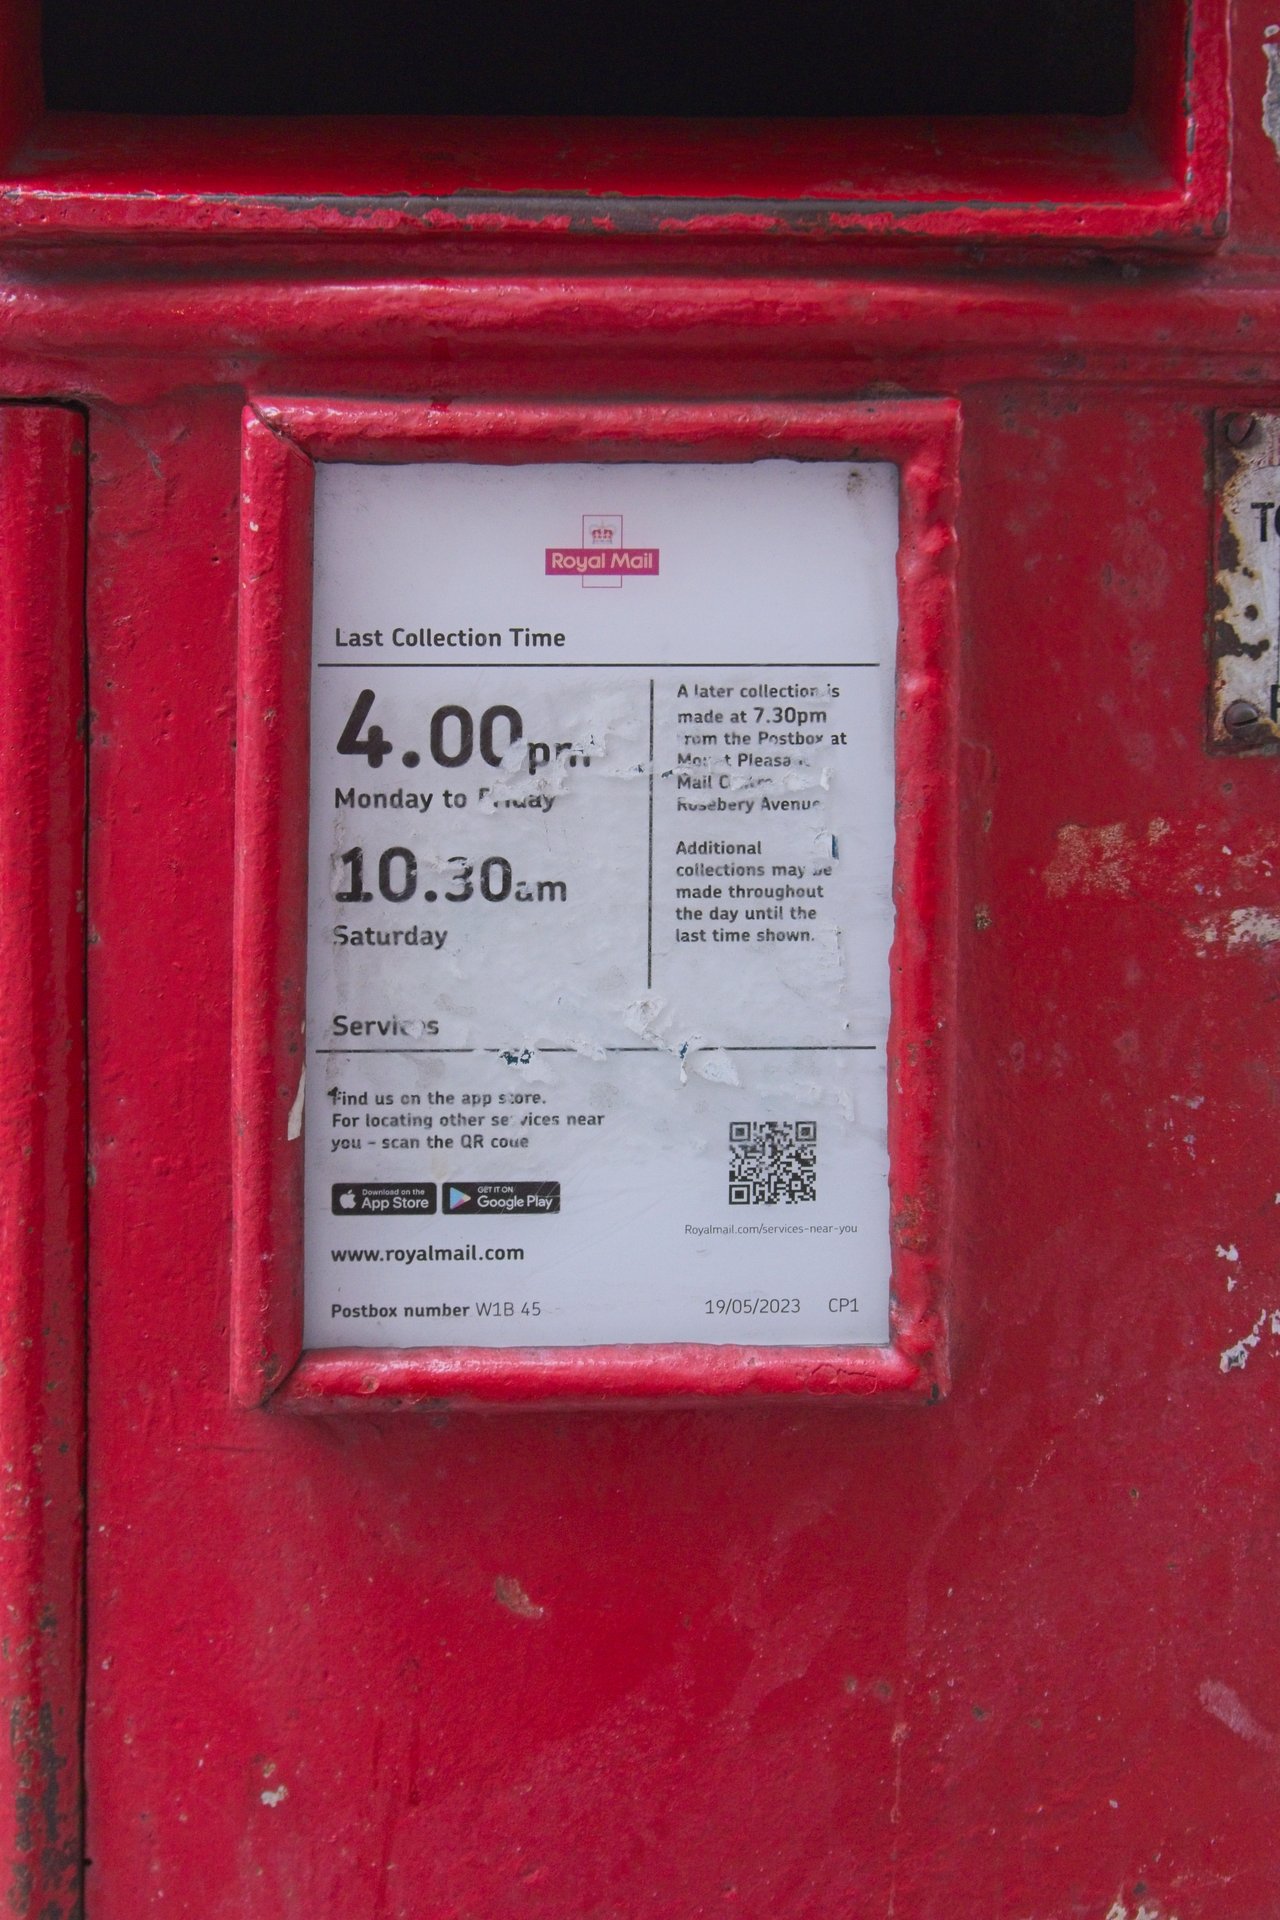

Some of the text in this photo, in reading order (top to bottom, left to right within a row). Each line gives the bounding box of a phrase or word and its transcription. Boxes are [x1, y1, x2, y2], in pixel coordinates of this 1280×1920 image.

[552, 552, 653, 573] Royal Mail
[336, 628, 566, 647] Last Collection Time
[677, 683, 839, 698] A later collection is
[678, 707, 827, 727] made at 7.30pm
[684, 732, 847, 745] rom the Postbox at
[677, 775, 712, 790] Mail
[335, 788, 433, 812] Monday
[443, 790, 467, 808] to
[676, 841, 762, 855] Additional
[335, 846, 567, 903] 10.30am
[676, 863, 765, 876] collections
[772, 866, 805, 879] may
[676, 884, 823, 901] made throughout
[676, 906, 816, 923] the day until the
[333, 925, 448, 950] Saturday
[676, 928, 815, 942] last time shown.
[375, 1093, 394, 1106] us
[401, 1093, 421, 1106] on
[428, 1092, 455, 1106] the
[461, 1093, 492, 1108] app
[332, 1113, 605, 1129] For locating other sevices near
[331, 1138, 361, 1152] you
[381, 1136, 420, 1149] scan
[426, 1136, 454, 1149] the
[460, 1135, 483, 1149] QR
[362, 1188, 399, 1196] Download
[412, 1188, 425, 1196] the
[477, 1186, 492, 1194] GET
[493, 1186, 499, 1194] IT
[362, 1197, 429, 1212] App Store
[477, 1195, 553, 1210] Google Play
[685, 1223, 858, 1236] Royalmail.com/services-near-you
[331, 1245, 525, 1266] www.royalmail.com
[331, 1301, 541, 1318] Postbox number W1B 45
[705, 1298, 859, 1315] 19/05/2023 CP1
